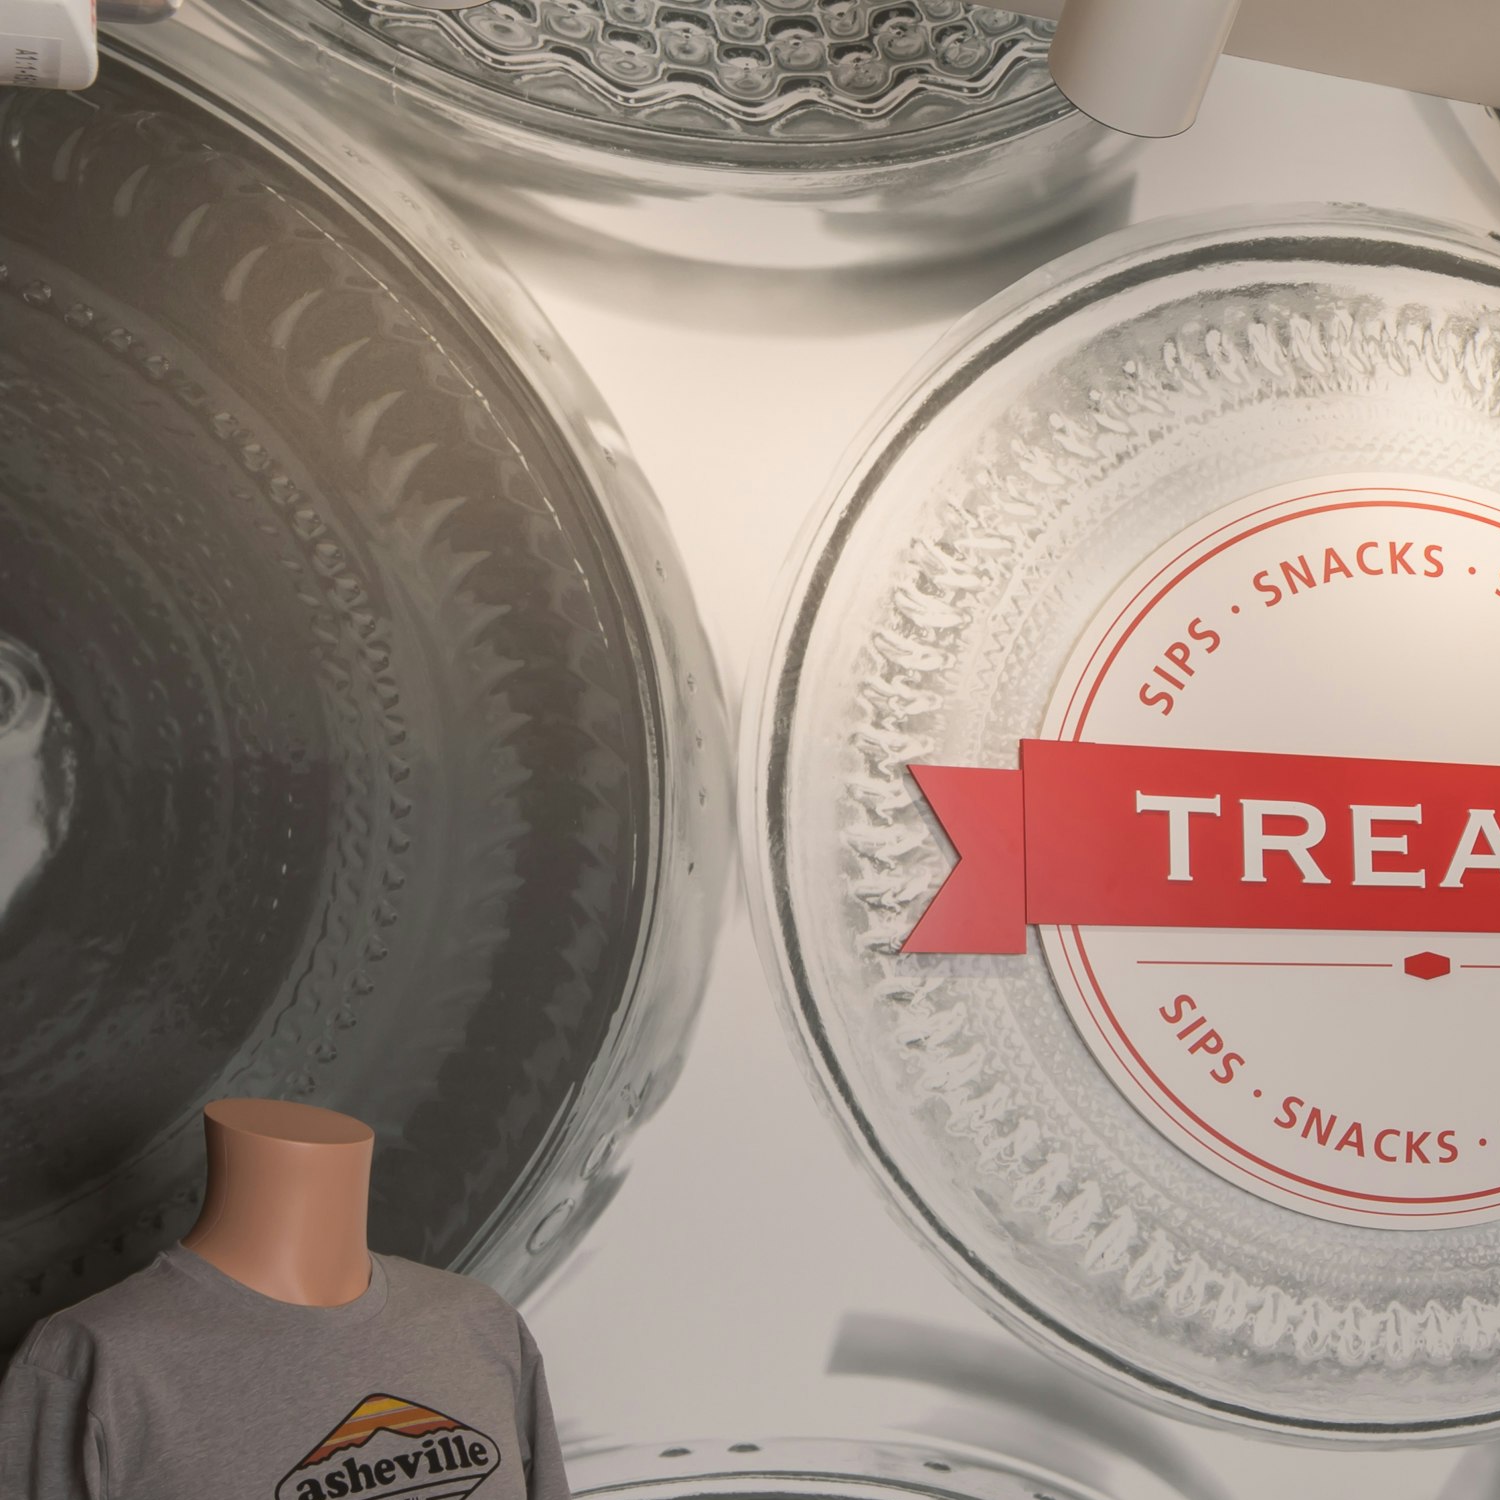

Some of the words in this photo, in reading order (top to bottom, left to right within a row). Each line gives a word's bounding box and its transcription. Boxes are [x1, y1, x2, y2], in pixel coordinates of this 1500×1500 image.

[1139, 617, 1223, 715] SIPS
[1252, 541, 1444, 607] SNACKS
[1158, 994, 1245, 1086] SIPS
[1274, 1096, 1458, 1164] SNACKS
